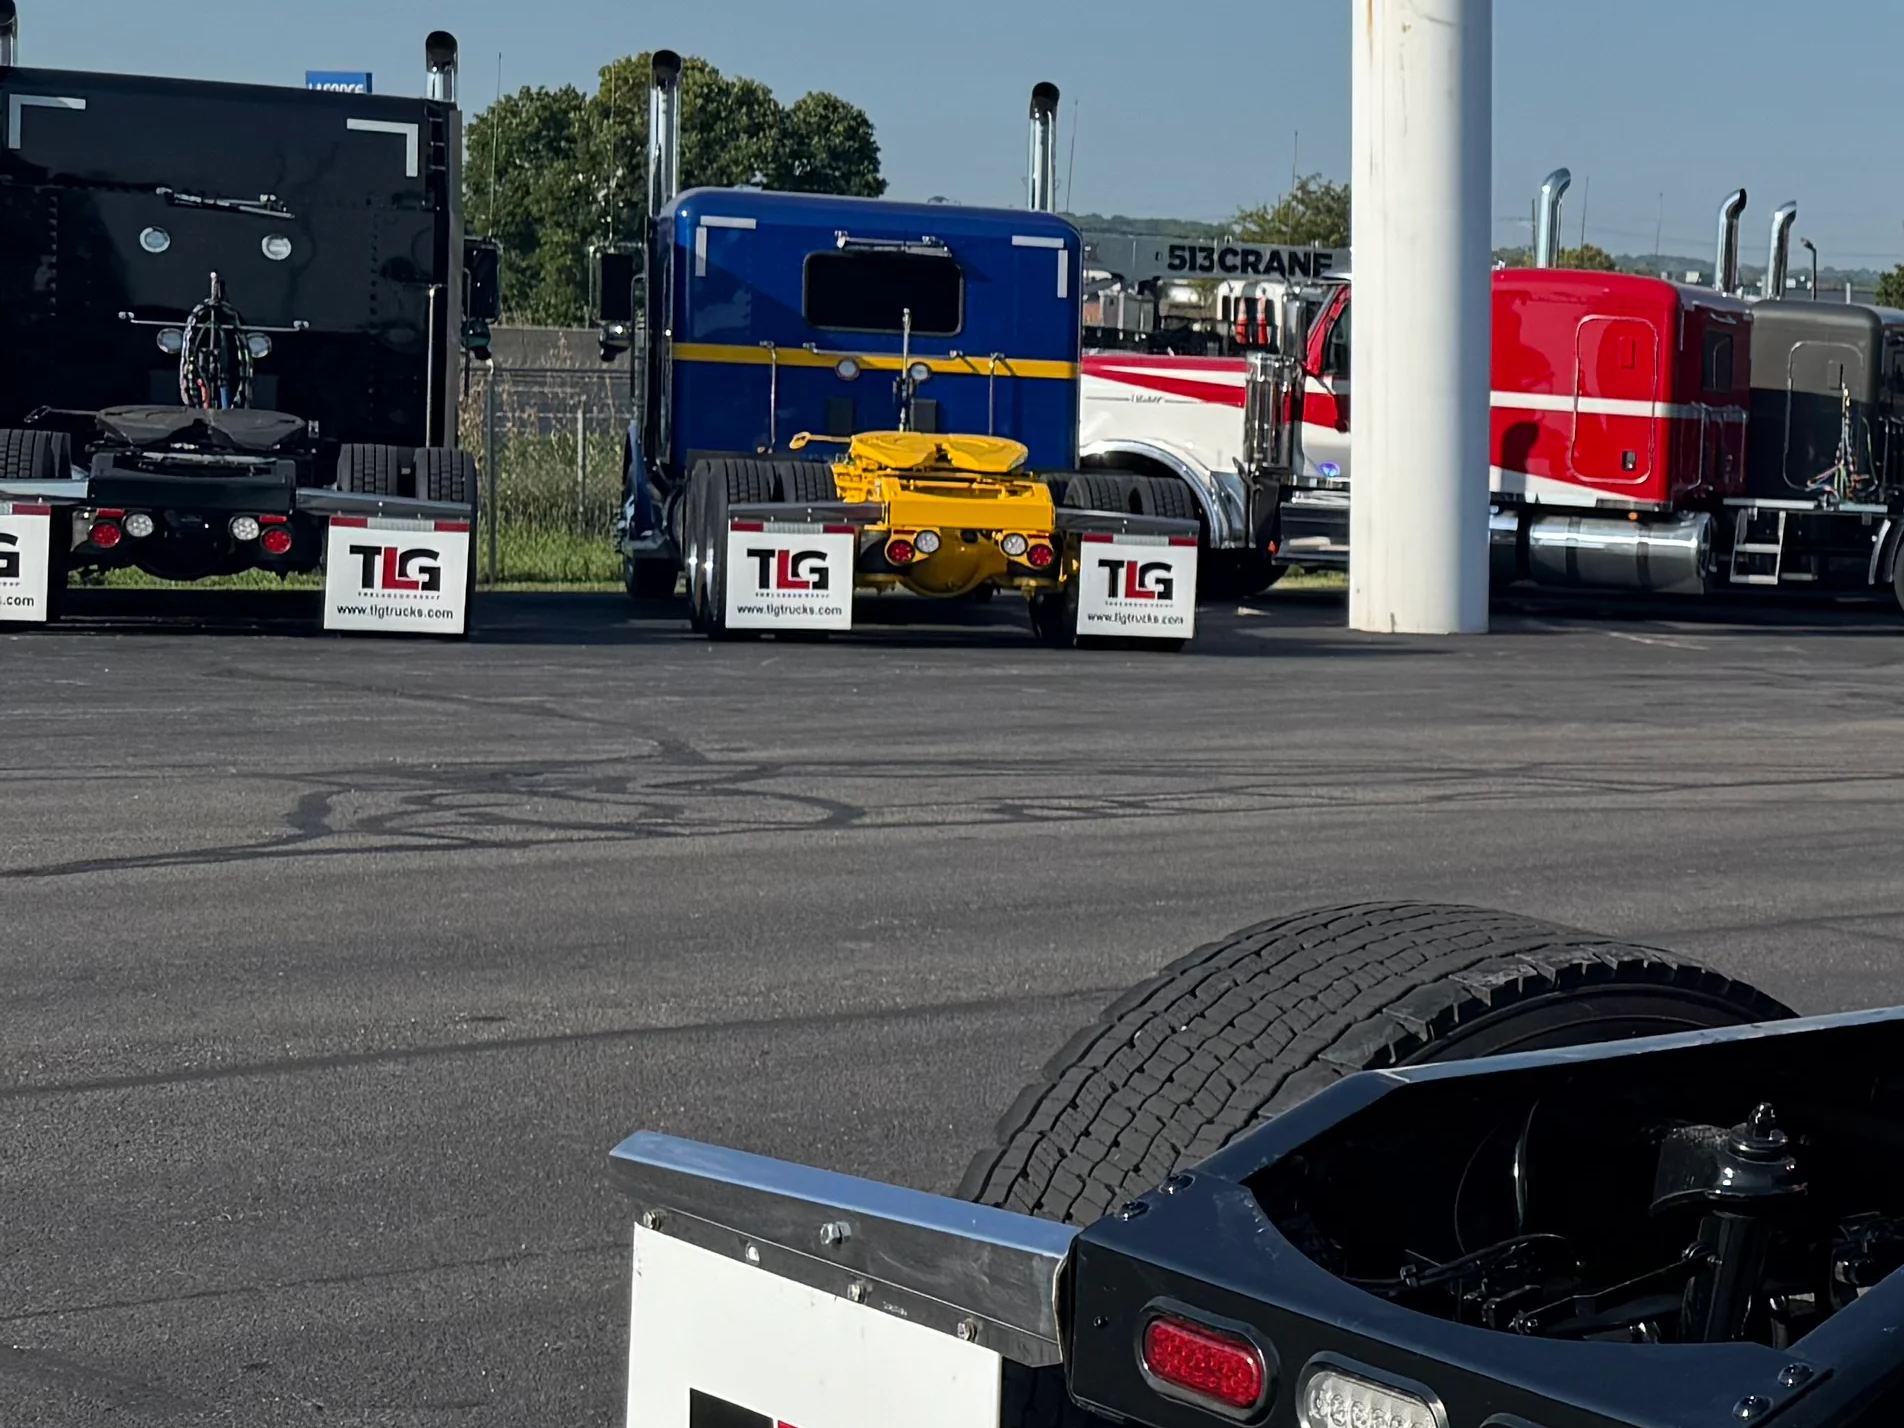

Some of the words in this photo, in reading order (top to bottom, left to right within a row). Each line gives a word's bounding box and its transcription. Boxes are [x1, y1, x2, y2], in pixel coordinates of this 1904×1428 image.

[349, 545, 441, 592] TLG
[747, 548, 829, 590] TLG
[1098, 559, 1174, 600] TLG
[336, 604, 453, 619] www.tlgtrucks.com
[737, 604, 842, 617] www.tlgtrucks.com
